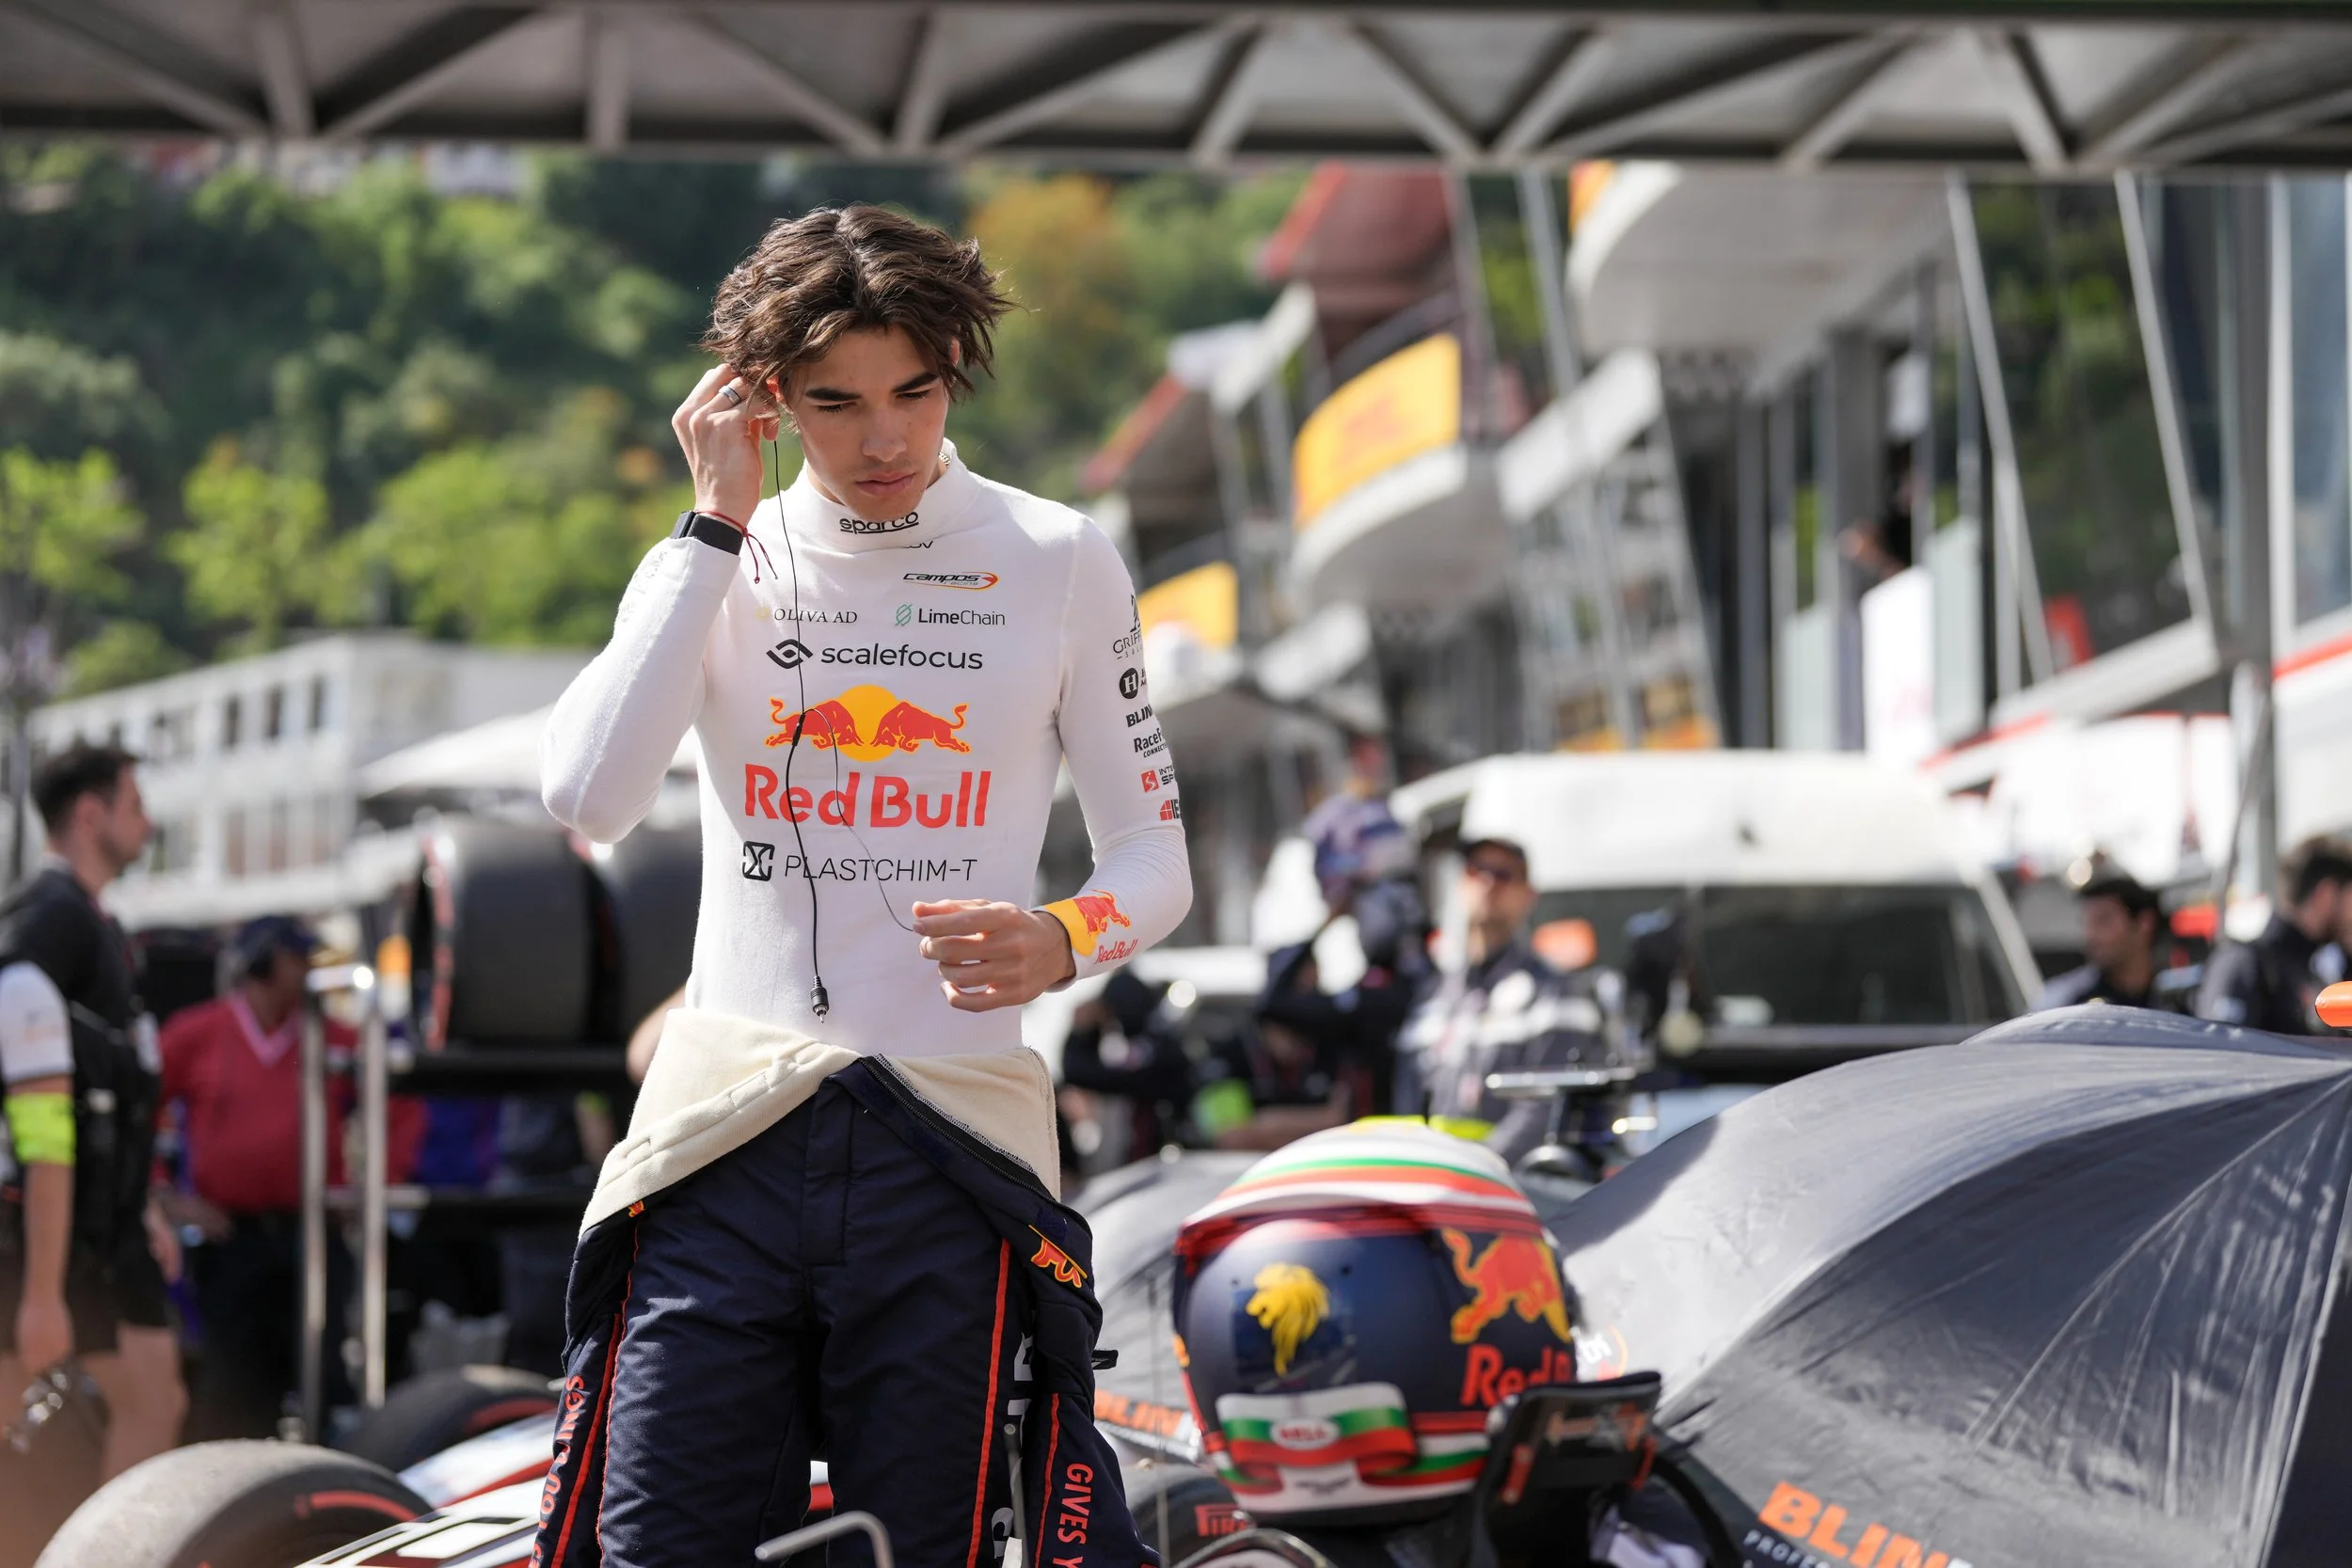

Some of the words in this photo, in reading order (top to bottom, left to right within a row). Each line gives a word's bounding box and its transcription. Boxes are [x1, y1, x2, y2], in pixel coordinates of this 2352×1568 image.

[839, 512, 919, 535] sparco
[773, 608, 828, 623] OLIVA
[834, 611, 858, 625] AD
[918, 608, 1006, 626] LimeChain
[820, 643, 984, 670] scalefocus
[744, 763, 861, 828] Red
[869, 770, 992, 829] Bull
[785, 855, 977, 882] PLASTCHIM-T
[1057, 1463, 1094, 1544] GIVES
